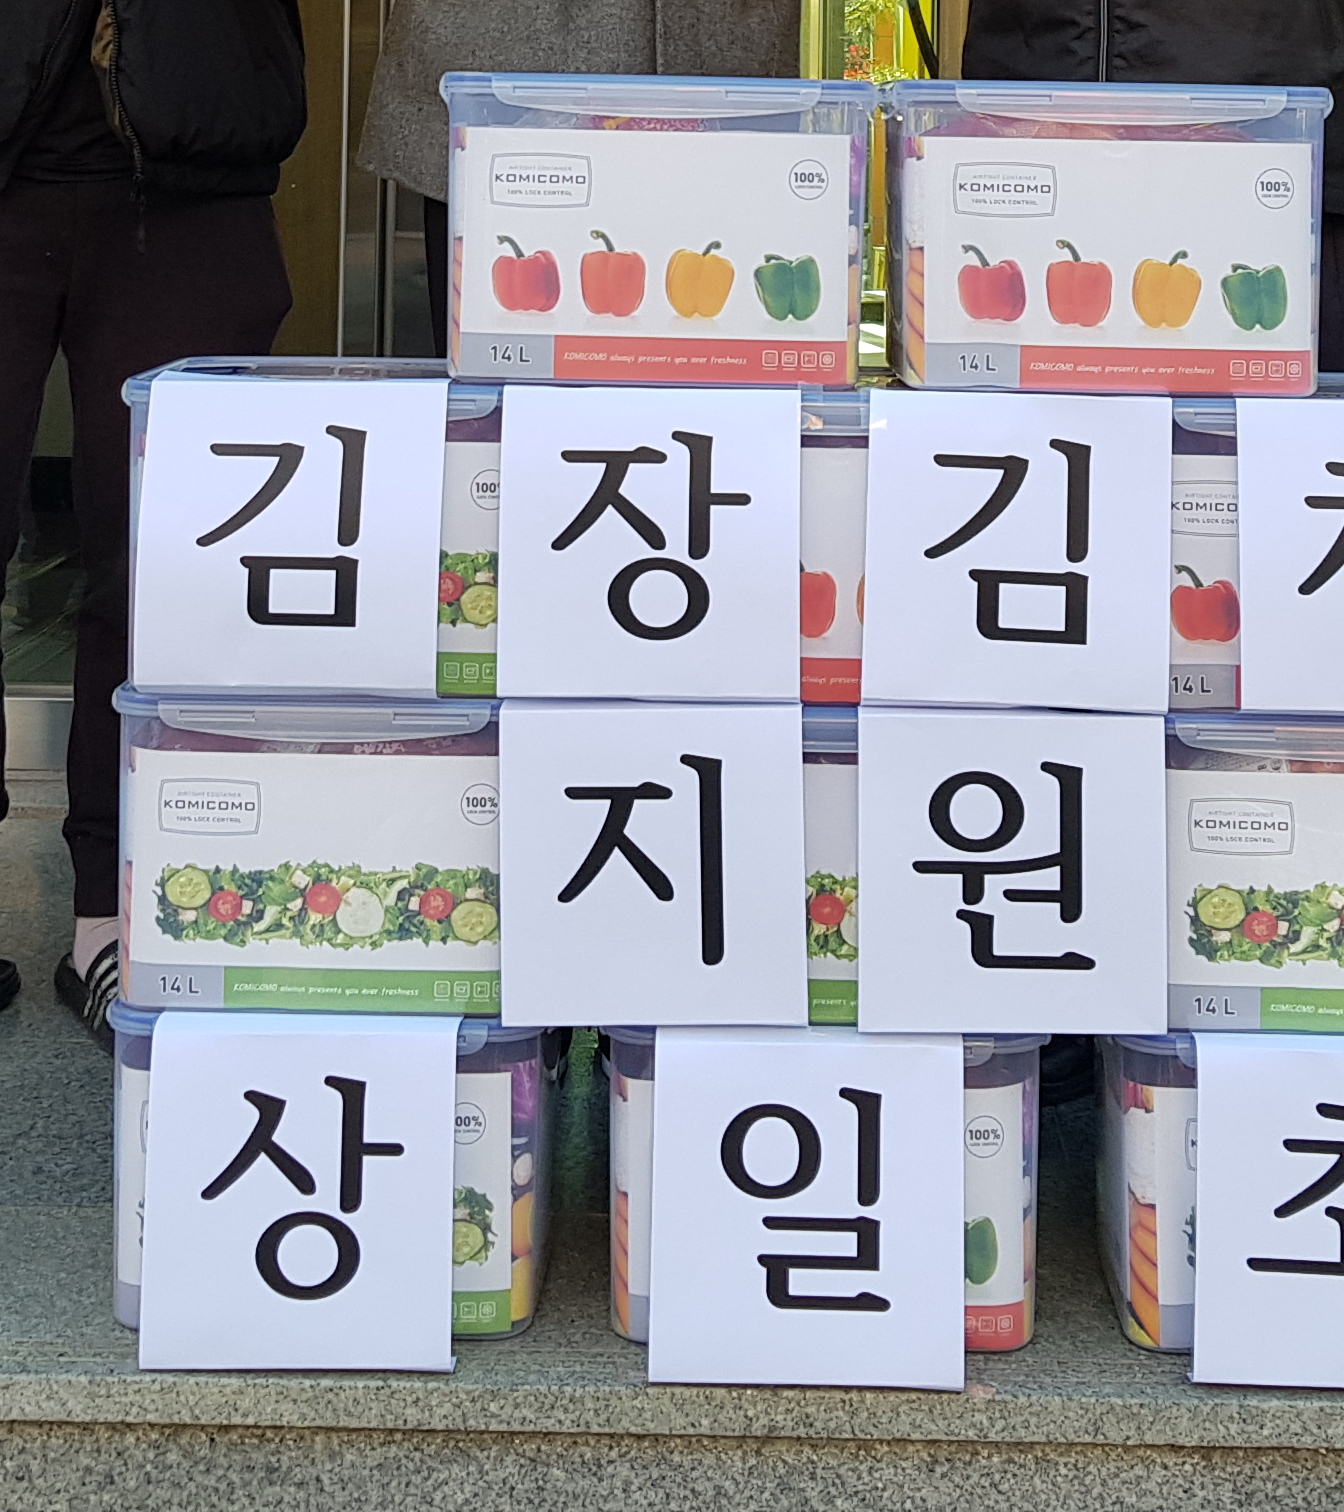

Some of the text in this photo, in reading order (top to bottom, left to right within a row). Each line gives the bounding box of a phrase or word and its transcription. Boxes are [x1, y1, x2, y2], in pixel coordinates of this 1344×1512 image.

[495, 173, 586, 185] KOMICOMO
[794, 172, 825, 183] 100%
[1260, 181, 1290, 192] 100%
[958, 182, 1051, 194] KOMICOMO
[489, 345, 531, 364] 14 L
[959, 353, 997, 372] 14 L
[1171, 501, 1238, 512] KOMICO
[196, 425, 367, 627] 김
[551, 430, 752, 641] 장
[923, 438, 1092, 645] 김
[1171, 676, 1211, 694] 14 L
[163, 799, 256, 811] KOMICOMO
[466, 797, 498, 808] 100%
[1193, 819, 1289, 831] KOMICOMO
[557, 753, 723, 966] 지
[912, 761, 1096, 970] 원
[159, 974, 200, 995] 14 L
[1194, 996, 1236, 1017] 14 L
[455, 1116, 482, 1127] 00%
[968, 1129, 1000, 1140] 100%
[201, 1075, 404, 1301] 상
[721, 1087, 891, 1311] 일
